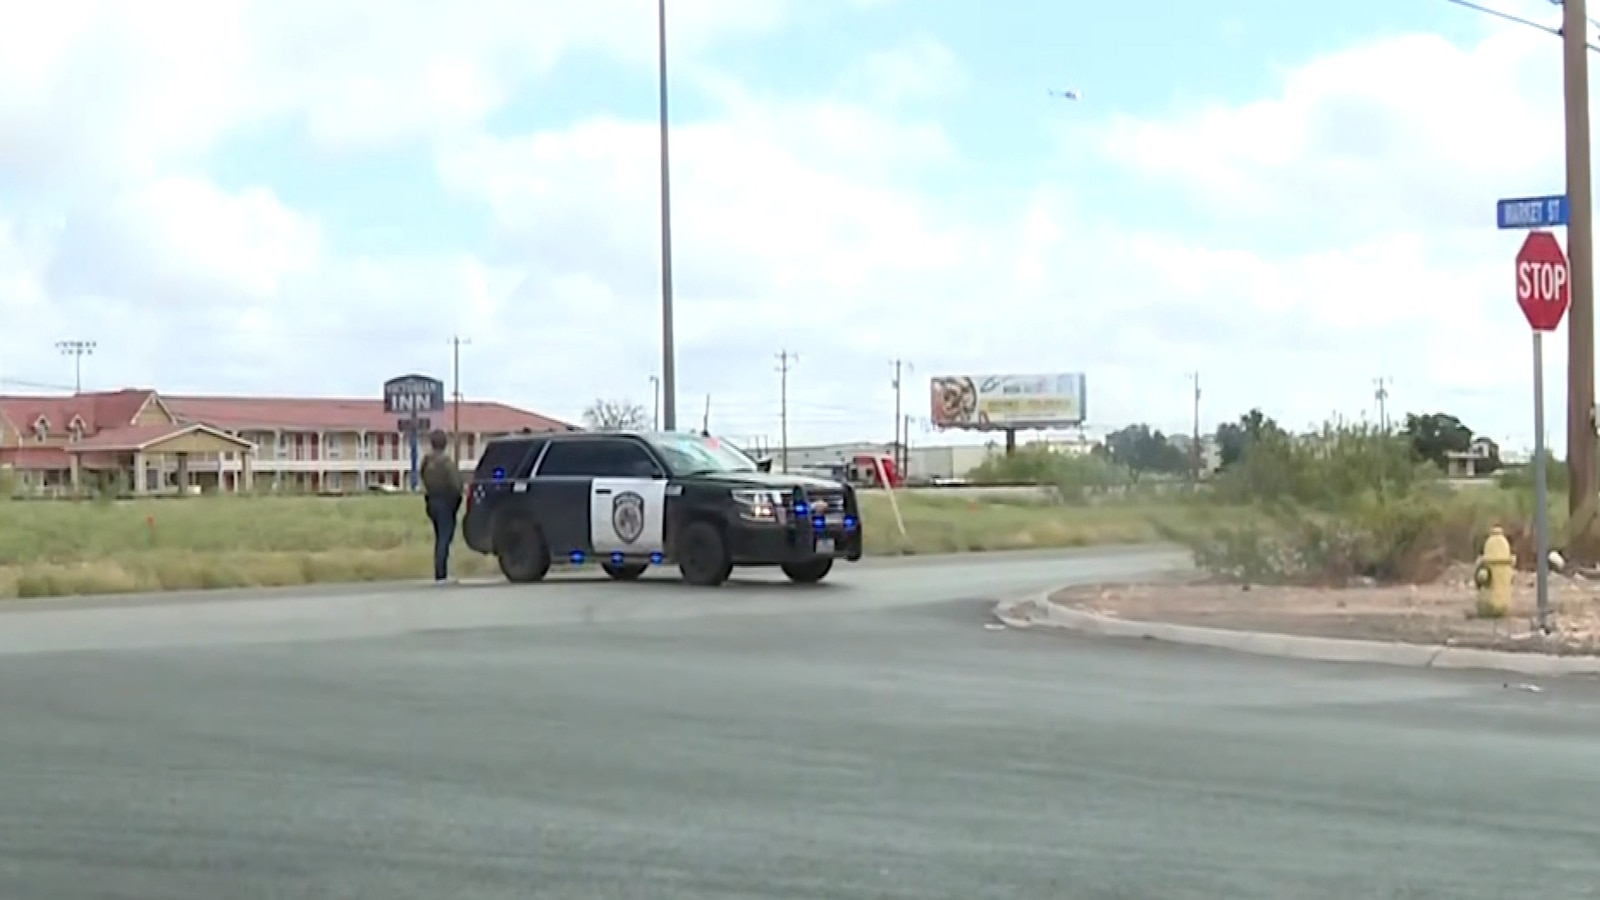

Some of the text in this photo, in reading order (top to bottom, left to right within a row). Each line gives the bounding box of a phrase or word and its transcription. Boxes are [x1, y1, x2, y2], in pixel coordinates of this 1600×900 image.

[1505, 199, 1560, 225] MARKET ST
[1519, 260, 1566, 300] STOP
[391, 394, 431, 411] INN
